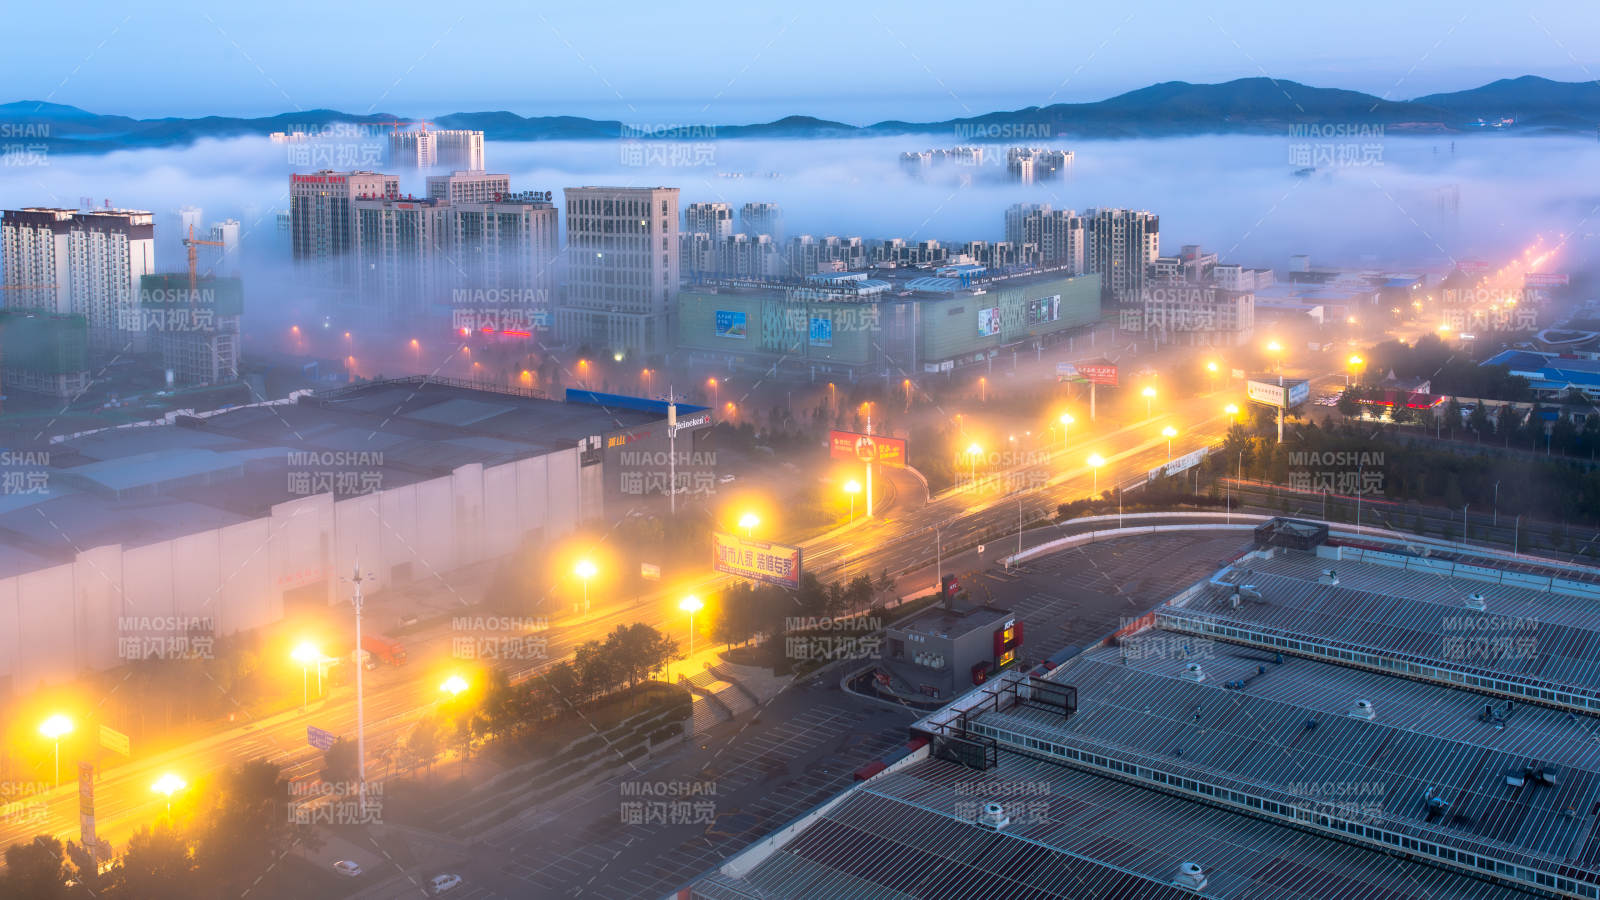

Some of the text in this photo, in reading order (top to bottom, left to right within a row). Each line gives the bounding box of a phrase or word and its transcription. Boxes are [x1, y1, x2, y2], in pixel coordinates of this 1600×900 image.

[676, 416, 704, 430] Heineken
[757, 551, 793, 577] 装修专家
[1004, 618, 1015, 630] KFC
